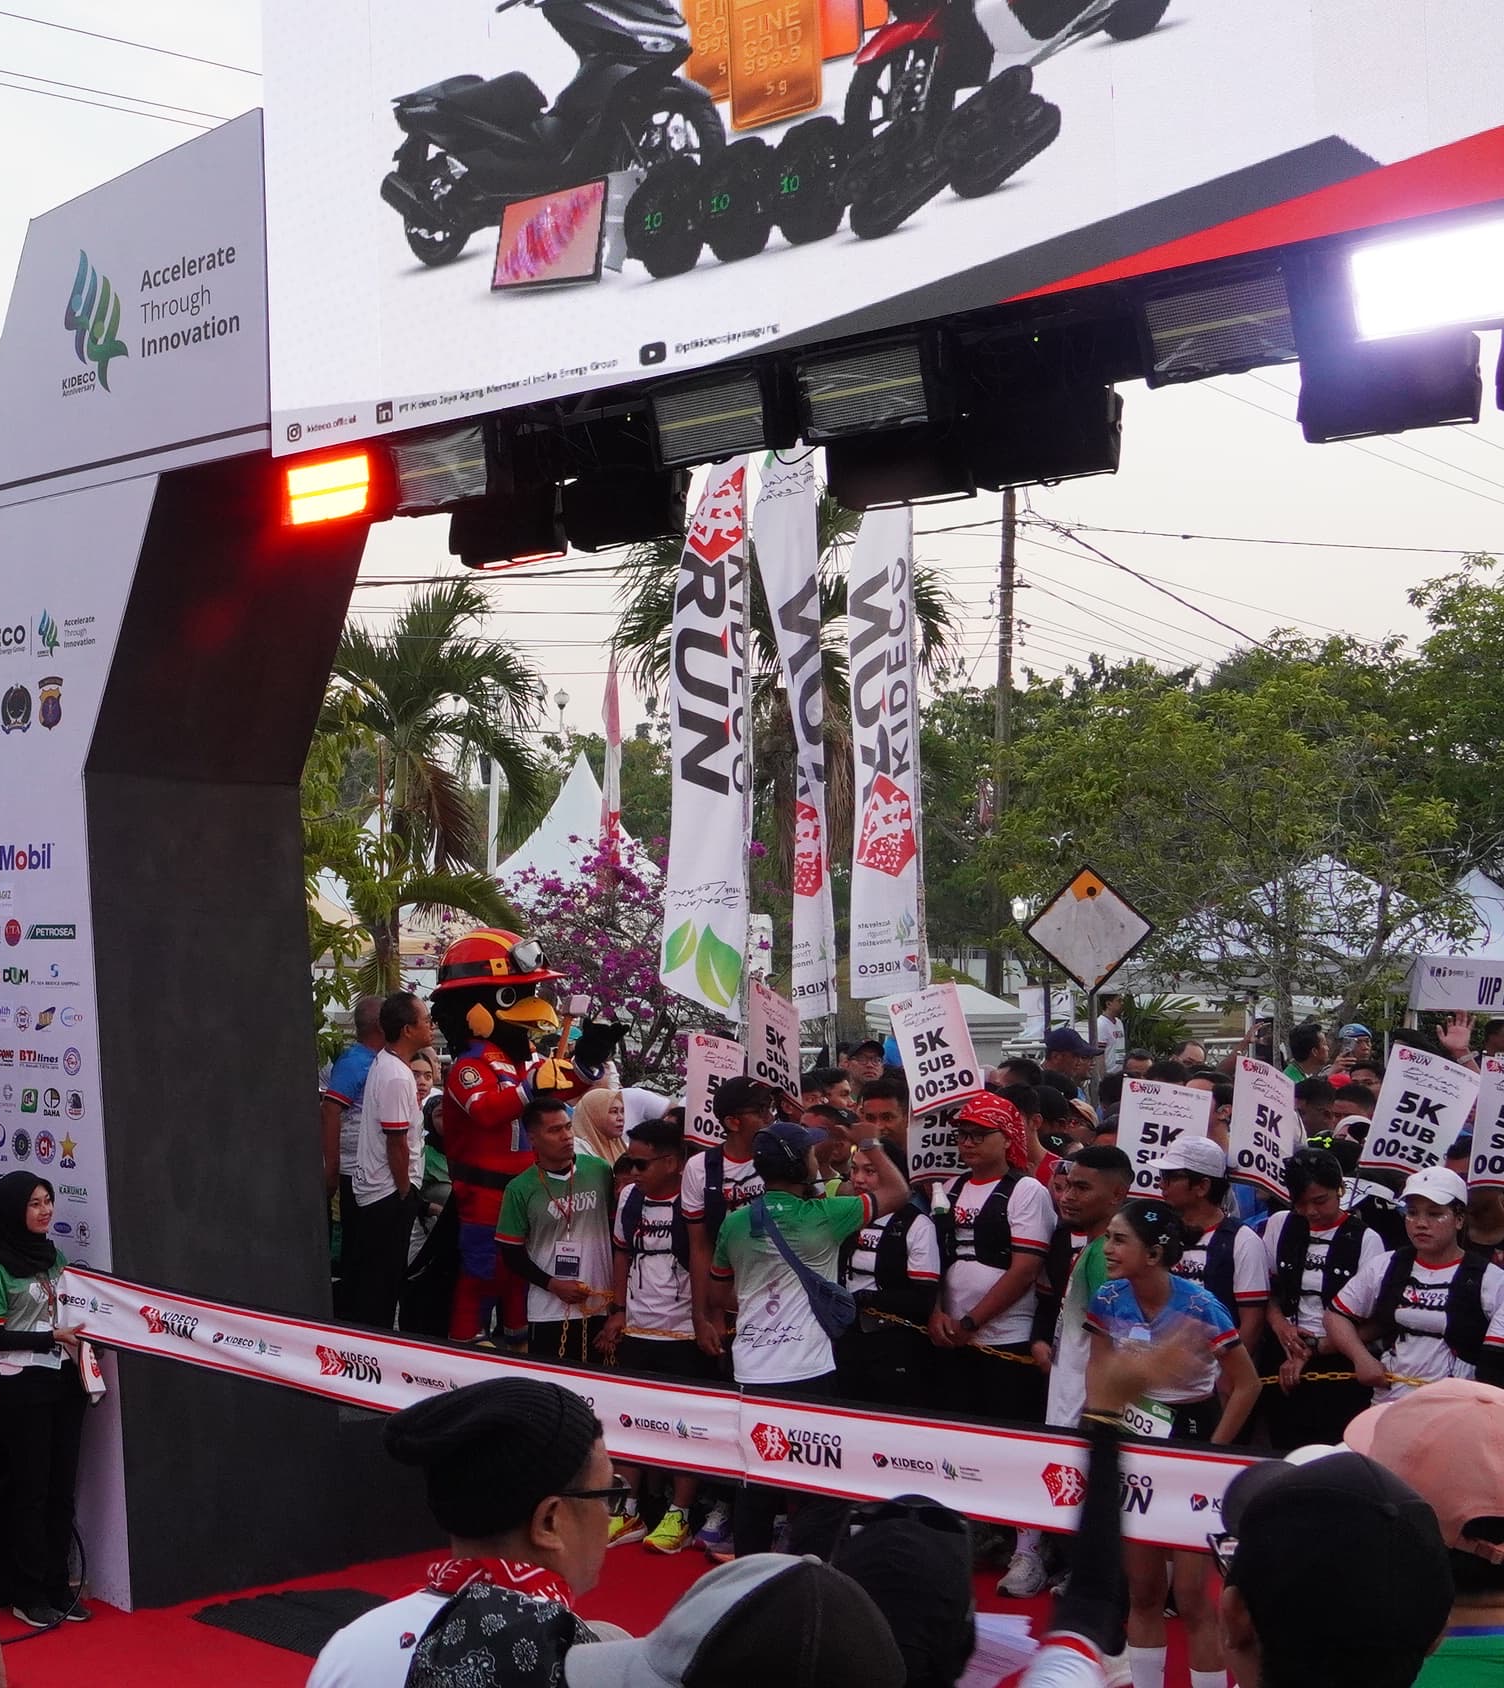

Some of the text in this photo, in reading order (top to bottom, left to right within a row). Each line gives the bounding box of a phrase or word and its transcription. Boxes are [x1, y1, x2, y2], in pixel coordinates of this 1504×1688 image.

[743, 3, 801, 40] FINE
[745, 27, 802, 58] GOLD
[745, 47, 801, 75] 999.9
[711, 194, 730, 213] 10
[644, 212, 662, 231] 10
[140, 246, 236, 292] Accelerate
[141, 284, 211, 324] Through
[141, 314, 240, 358] Innovation
[62, 370, 96, 390] KIDECO
[64, 615, 95, 626] Accelerate
[64, 638, 96, 649] Innovation
[674, 550, 729, 796] RUN
[0, 843, 52, 871] Mobil
[35, 928, 75, 937] PETROSEA
[1478, 976, 1502, 1006] VIP
[766, 1024, 787, 1056] 5K
[913, 1027, 949, 1057] 5K
[766, 1048, 789, 1073] SUB
[918, 1054, 955, 1077] SUB
[756, 1061, 798, 1098] 00:30
[915, 1069, 974, 1102] 00:30
[1396, 1090, 1448, 1126] 5K
[1255, 1104, 1282, 1138] 5K
[1389, 1118, 1436, 1144] SUB
[1139, 1122, 1184, 1147] 5K
[1253, 1131, 1280, 1159] SUB
[1372, 1138, 1440, 1168] 00:35
[66, 1295, 86, 1306] DECO
[160, 1320, 196, 1341] RUN
[161, 1311, 198, 1327] KIDECO
[224, 1336, 255, 1348] KIDECO
[340, 1350, 378, 1367] KIDECO
[341, 1361, 382, 1384] RUN
[414, 1375, 445, 1388] KIDECO
[634, 1417, 670, 1431] KIDECO
[787, 1428, 842, 1447] KIDECO
[787, 1441, 842, 1469] RUN
[890, 1456, 934, 1472] KIDECO
